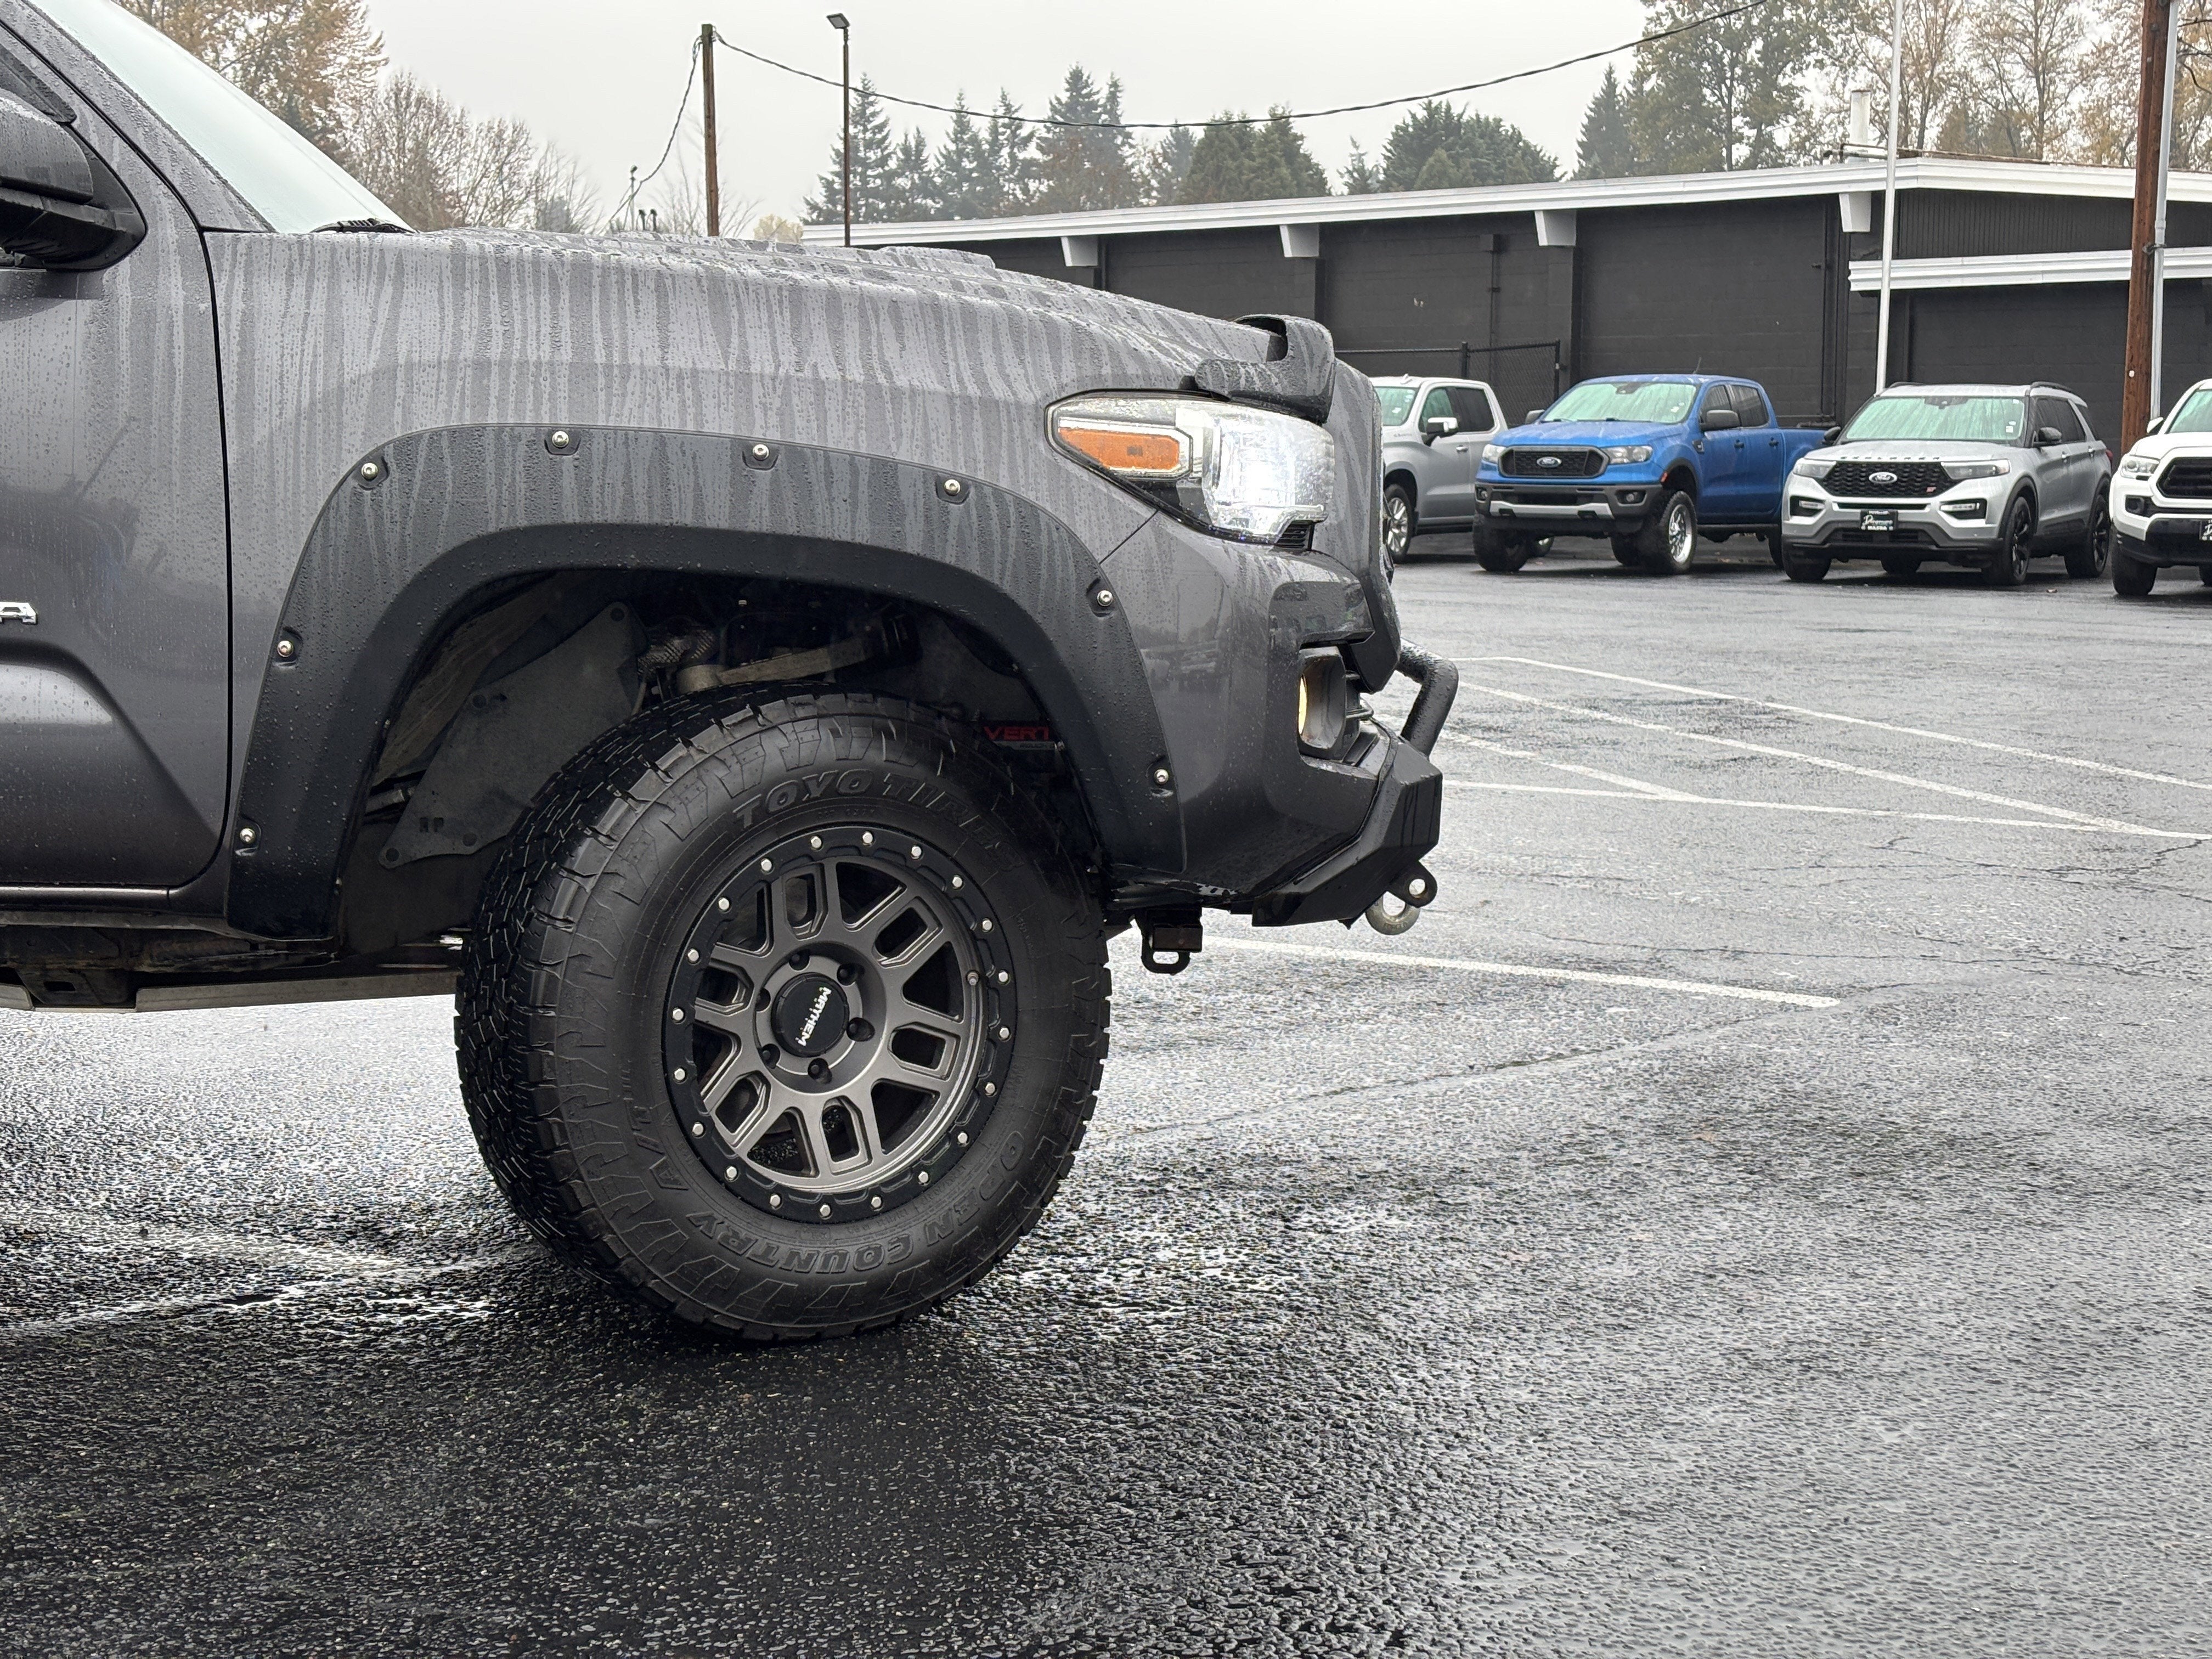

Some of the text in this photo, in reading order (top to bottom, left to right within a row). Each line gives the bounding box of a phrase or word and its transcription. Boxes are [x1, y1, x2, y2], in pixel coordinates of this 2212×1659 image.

[733, 769, 875, 827] TOYO
[795, 987, 832, 1047] MAYHEM
[924, 1130, 1025, 1247] OPEN
[685, 1211, 914, 1274] COUNTRY
